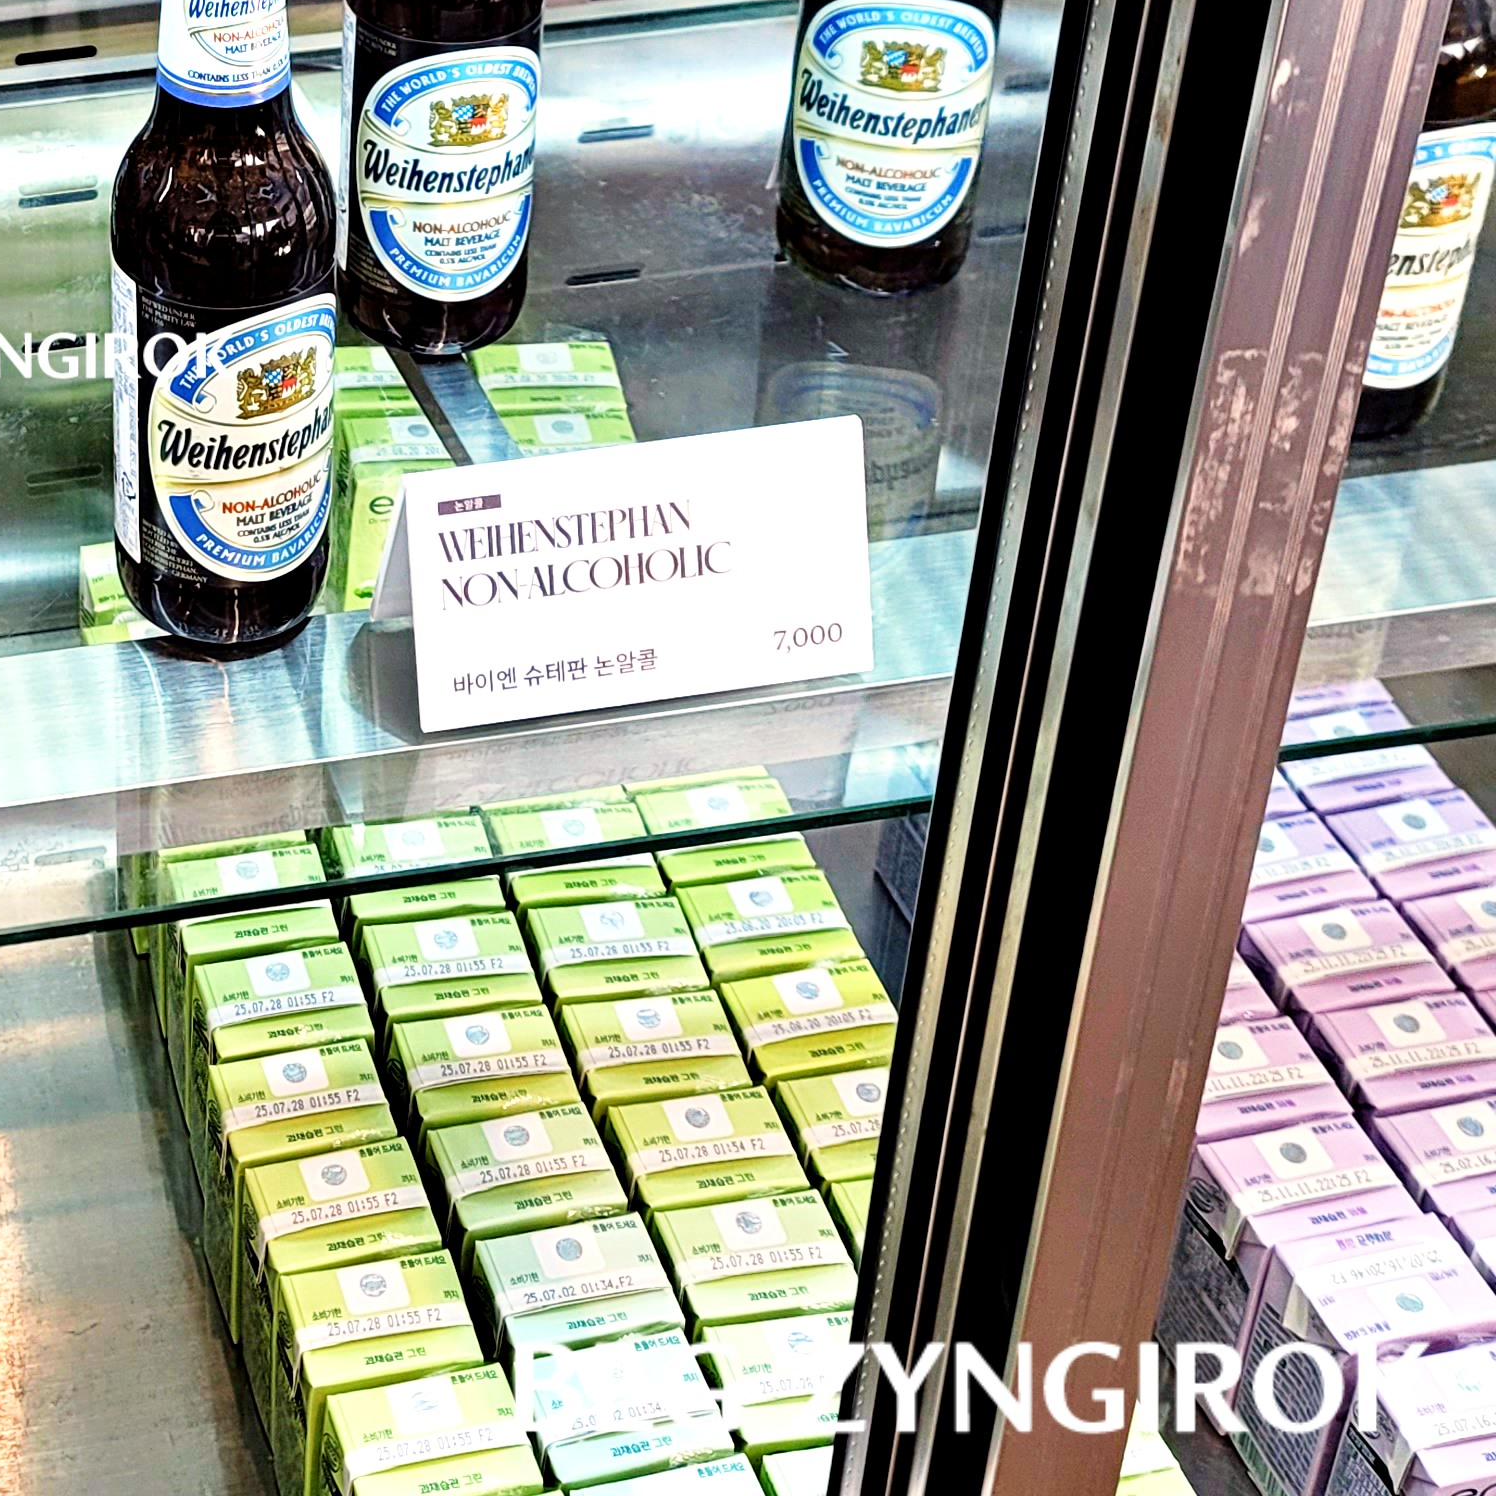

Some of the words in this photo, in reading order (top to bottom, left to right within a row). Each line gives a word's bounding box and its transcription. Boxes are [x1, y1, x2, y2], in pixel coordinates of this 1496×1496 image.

[225, 44, 248, 54] MALT
[188, 69, 229, 82] CONTAINS
[232, 73, 249, 82] LESS
[800, 68, 988, 144] Weihenstephaner
[363, 136, 535, 194] Weihenstephan
[812, 178, 868, 227] PREMIUM
[874, 194, 953, 233] BAVARICUM
[413, 211, 511, 234] NON-ALCOHOLIC
[389, 248, 450, 288] PREMIUM
[456, 235, 521, 288] BAVARICUM
[274, 316, 317, 336] OLDEST
[157, 401, 334, 471] Weihenstepha
[222, 471, 322, 514] NON-ALCOHOLIC
[454, 497, 484, 512] 논알콜
[438, 499, 692, 564] WEIHENSTEPHAN
[195, 533, 265, 567] PREMIUM
[442, 541, 733, 611] NON-ALCOHOLIC
[773, 622, 844, 654] 7,000
[453, 666, 518, 697] 바이엔
[523, 657, 588, 688] 슈테판
[594, 647, 658, 678] 논알콜
[234, 998, 282, 1016] 25.07.28
[287, 992, 317, 1008] 01:55
[322, 990, 335, 1003] F2
[255, 1099, 304, 1118] 25.07.28
[310, 1092, 342, 1108] 01:55
[346, 1089, 360, 1103] F2
[659, 1145, 709, 1163] 25.07.28
[714, 1140, 746, 1156] 01:54
[751, 1138, 766, 1152] F2
[1355, 1170, 1372, 1184] F2
